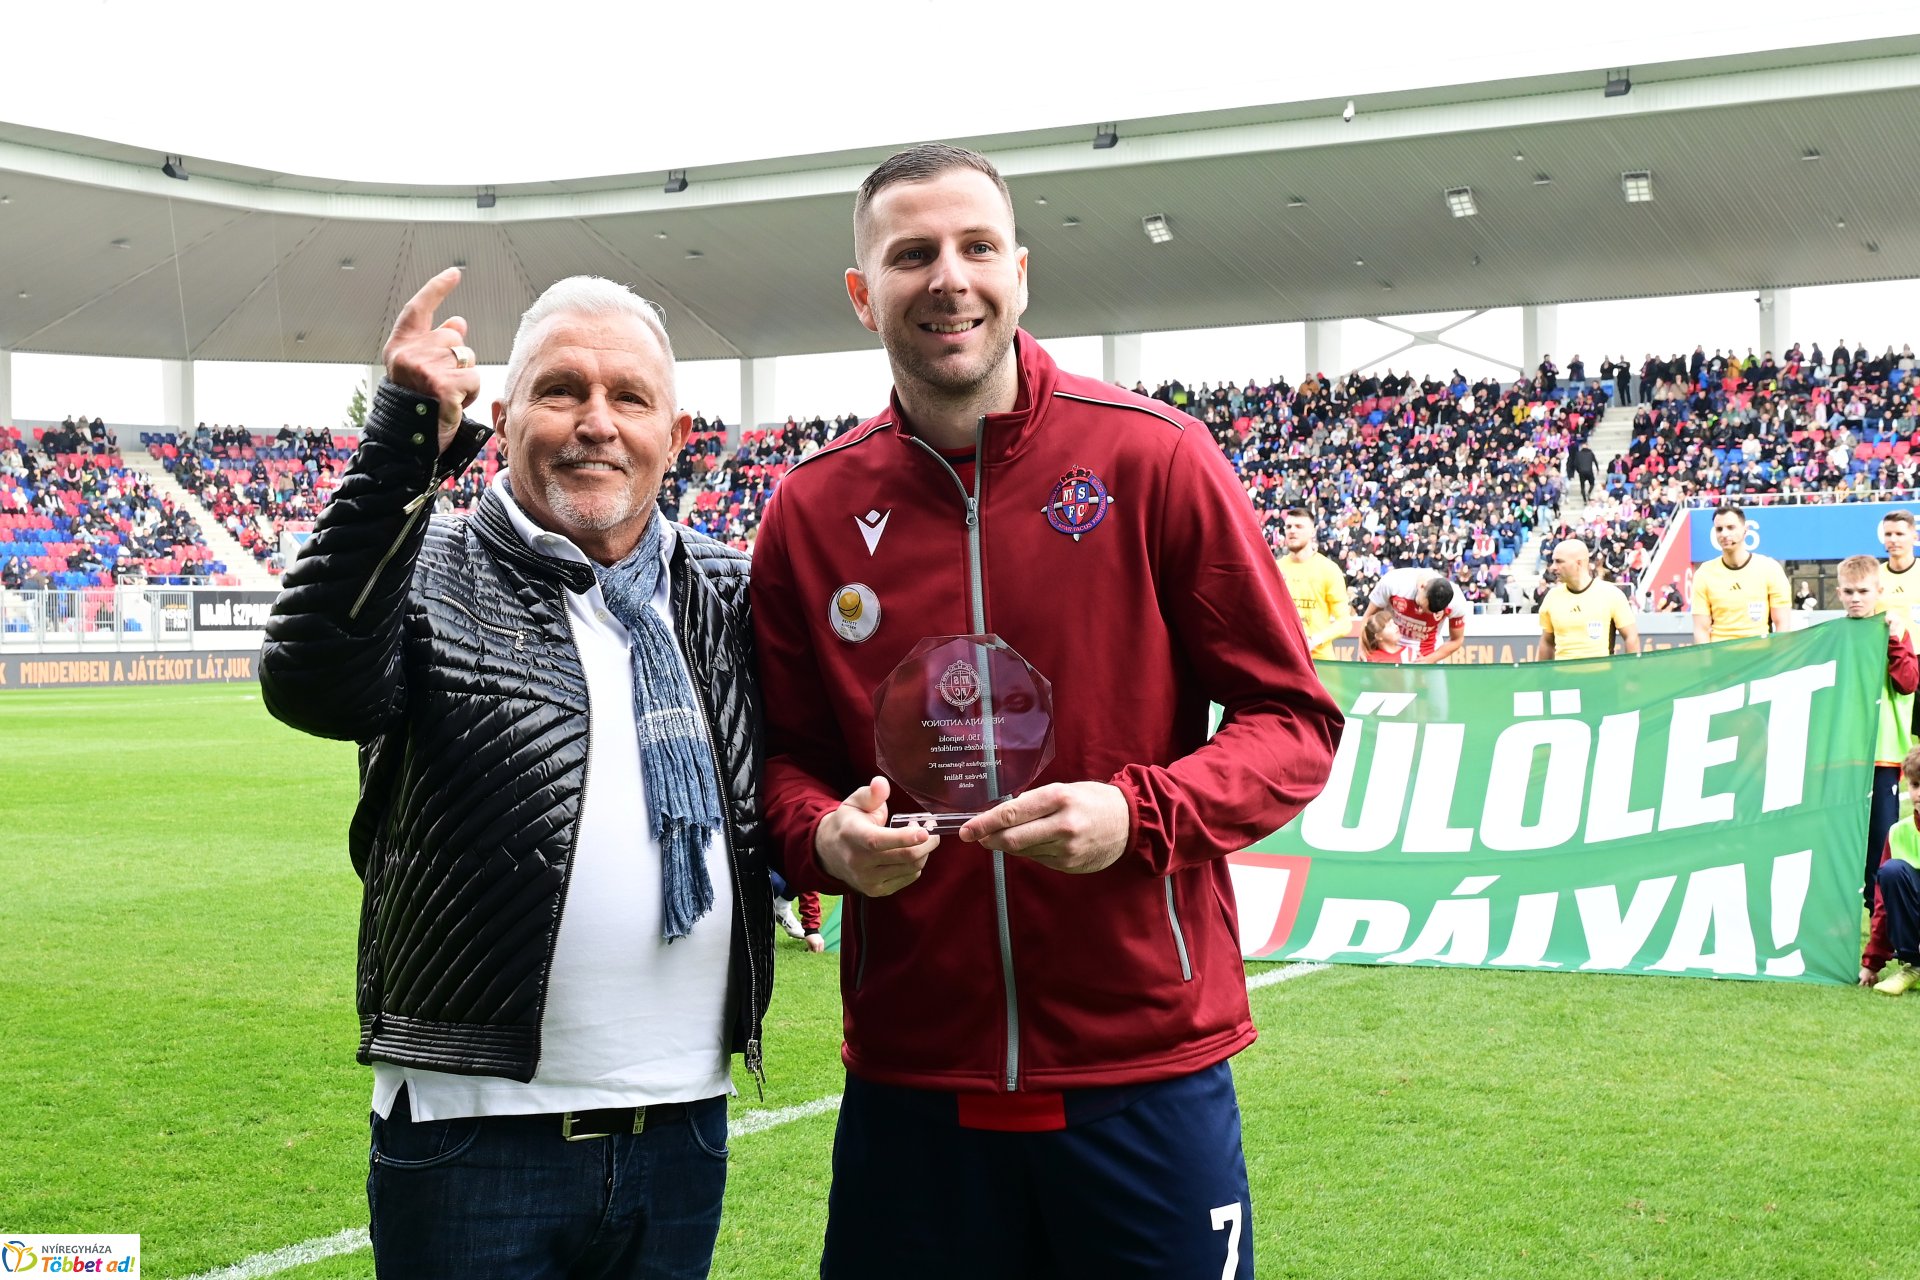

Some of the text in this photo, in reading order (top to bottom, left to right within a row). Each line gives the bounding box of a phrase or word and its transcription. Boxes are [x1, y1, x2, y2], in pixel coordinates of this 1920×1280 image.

[1063, 486, 1086, 502] NY S
[1068, 504, 1085, 518] F C
[20, 660, 110, 684] MINDENBEN
[113, 661, 124, 682] A
[128, 655, 193, 681] JÁTÉKOT
[197, 654, 251, 680] LÁTJUK
[1300, 660, 1837, 853] ŰLÖLET
[1210, 1201, 1242, 1280] 7
